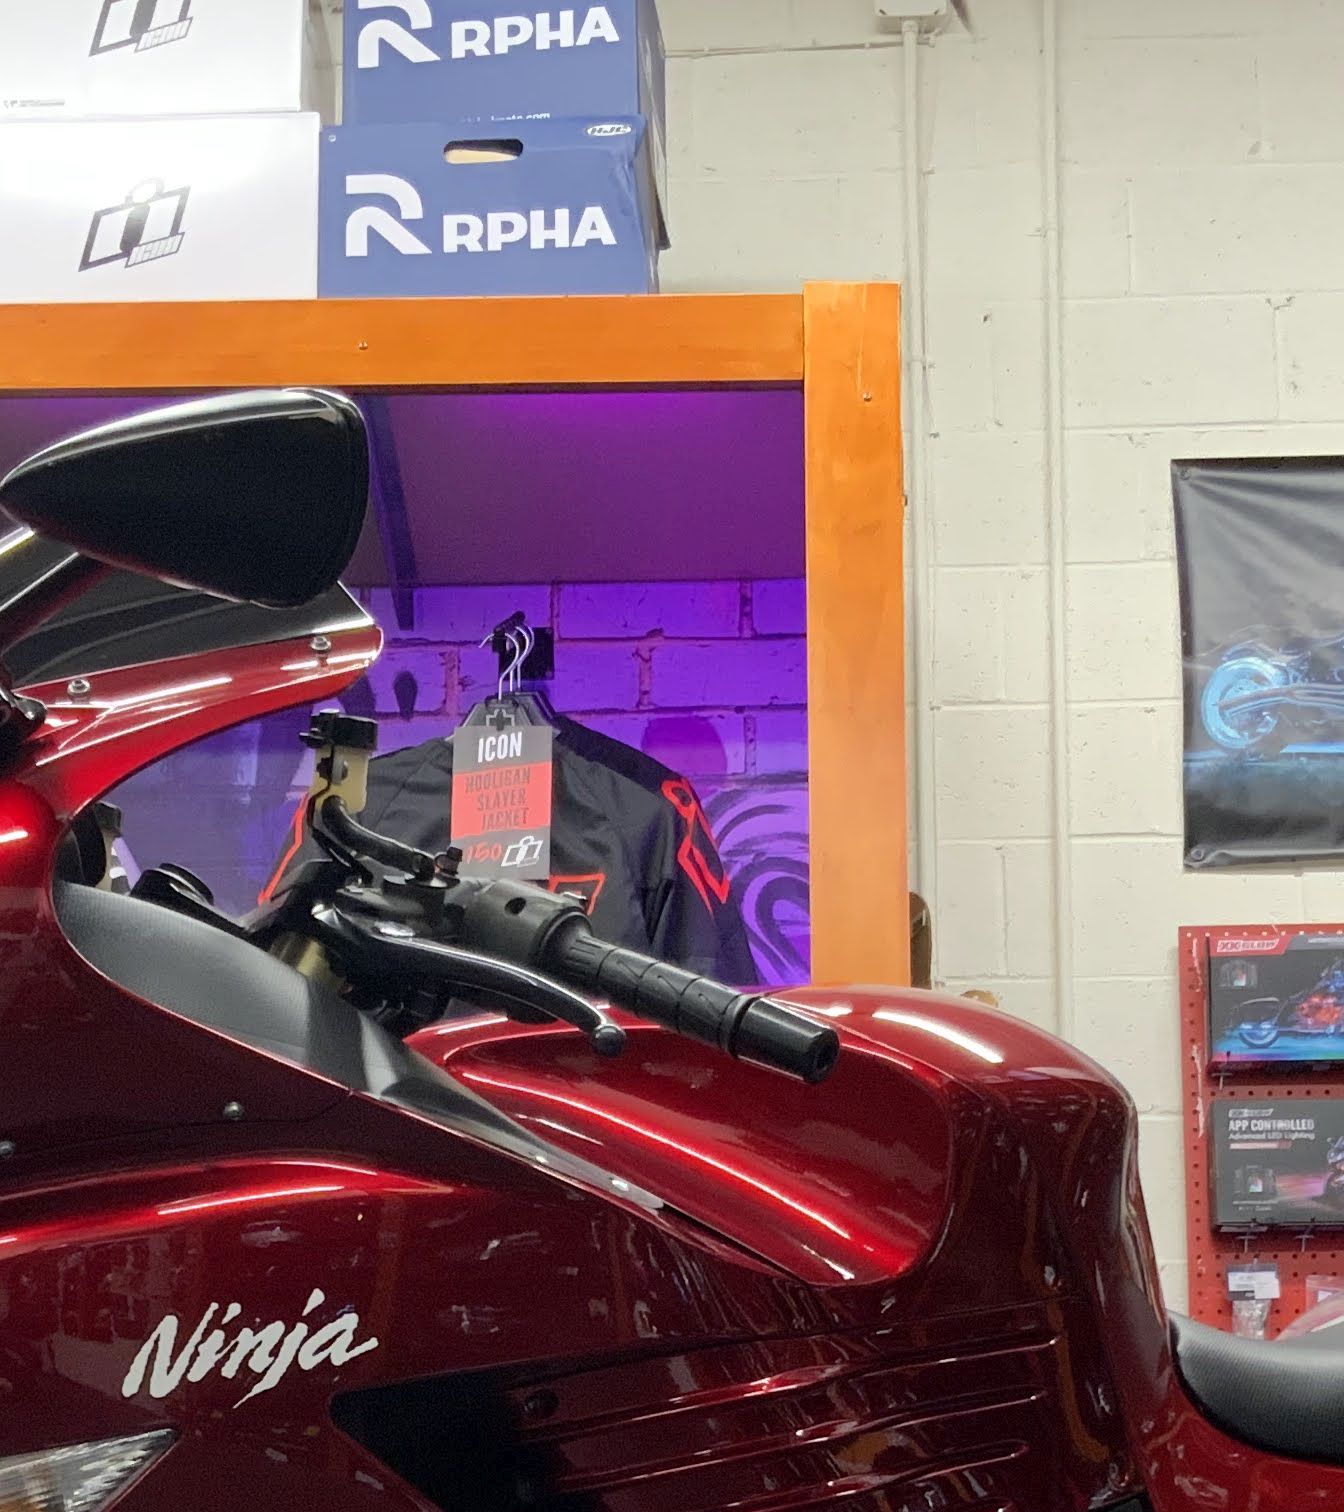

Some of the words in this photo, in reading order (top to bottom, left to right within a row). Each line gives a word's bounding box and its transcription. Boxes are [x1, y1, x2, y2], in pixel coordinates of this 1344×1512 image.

[451, 6, 620, 59] RPHA
[442, 206, 617, 254] RPHA
[477, 732, 523, 763] ICON
[464, 767, 531, 794] HOOLIGAN
[476, 789, 527, 812] SLAYER
[482, 807, 530, 832] JACKET
[1228, 1119, 1248, 1132] APP
[1250, 1118, 1316, 1131] CONTROLLED
[121, 1287, 379, 1410] Ninja
